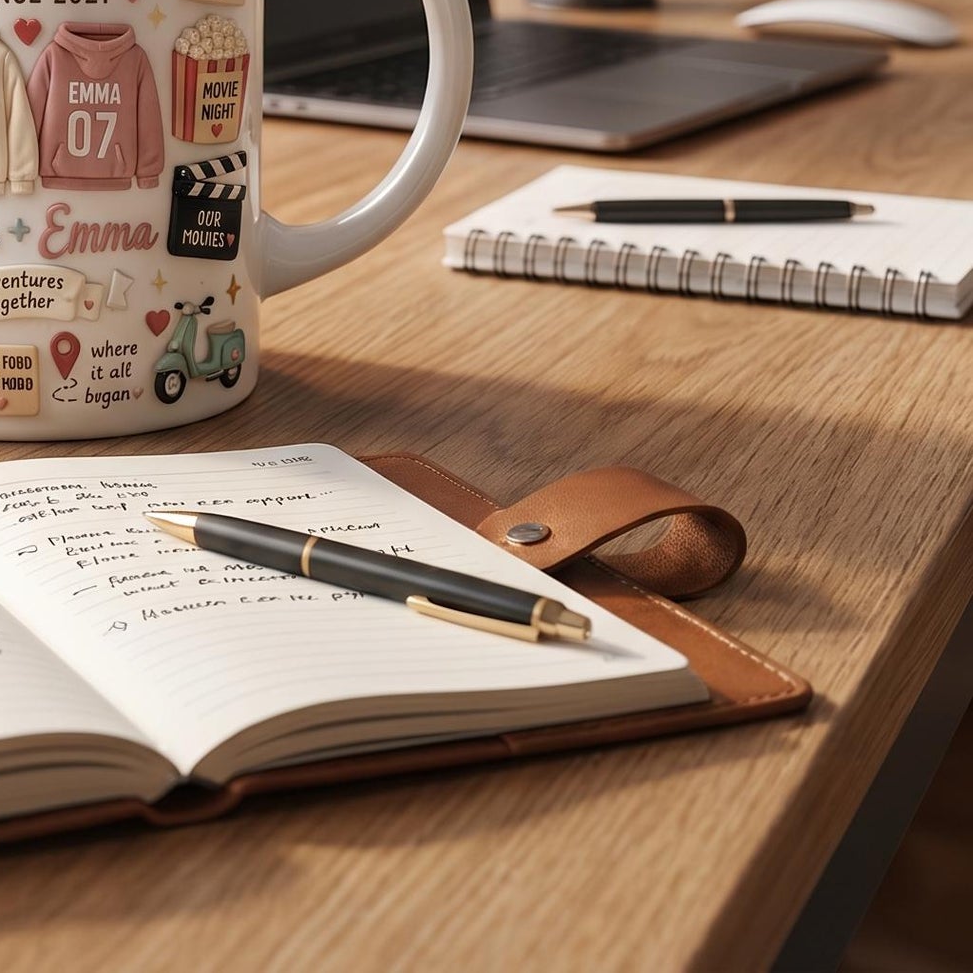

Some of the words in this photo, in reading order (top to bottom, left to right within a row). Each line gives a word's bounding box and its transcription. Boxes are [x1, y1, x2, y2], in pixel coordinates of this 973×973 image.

[68, 81, 121, 105] EMMA
[202, 81, 238, 99] MOVIE
[201, 103, 235, 120] NIGHT
[67, 110, 118, 159] 07
[197, 210, 222, 227] OUR
[38, 202, 159, 260] Emma
[91, 340, 138, 358] where
[91, 365, 104, 380] it
[109, 361, 132, 379] all
